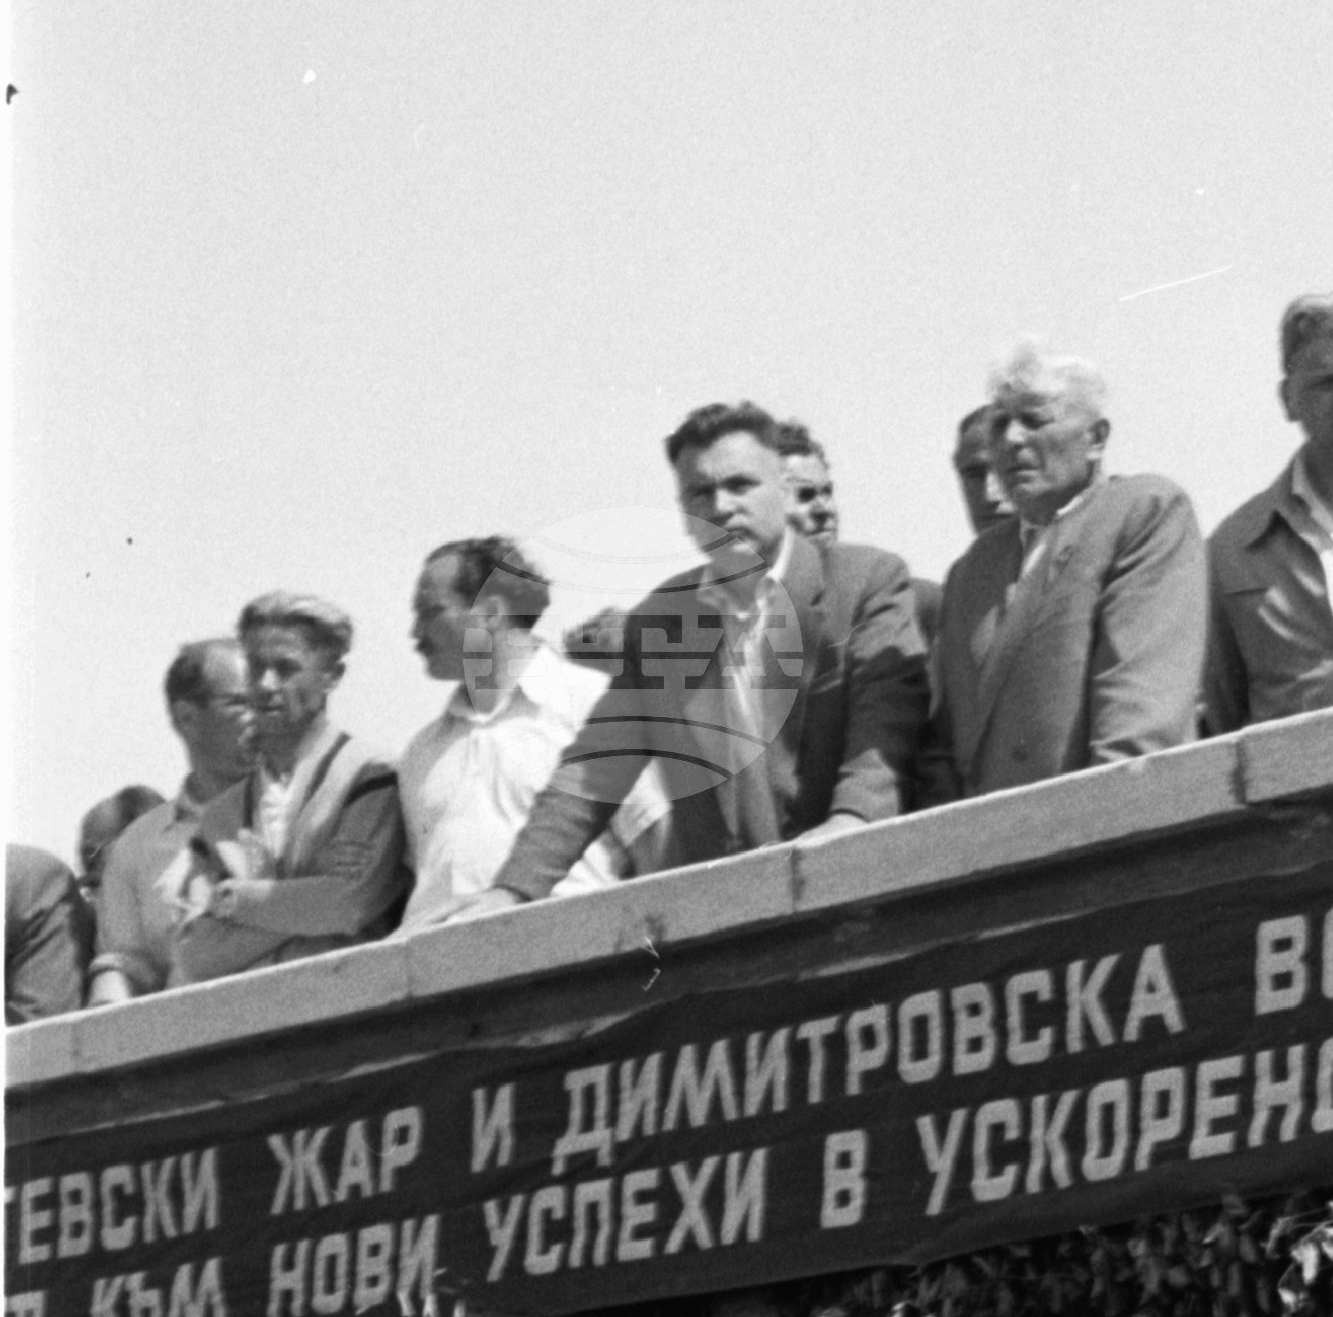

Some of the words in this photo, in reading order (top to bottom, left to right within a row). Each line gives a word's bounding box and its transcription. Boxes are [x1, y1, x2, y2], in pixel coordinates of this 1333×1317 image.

[4, 1146, 219, 1264] ЕВСКИ
[266, 1105, 424, 1215] ЖАР
[470, 1083, 515, 1174] И
[552, 943, 1186, 1176] ДИМИТРОВСКА
[482, 1147, 770, 1283] УСПЕХИ
[819, 1128, 868, 1230] В
